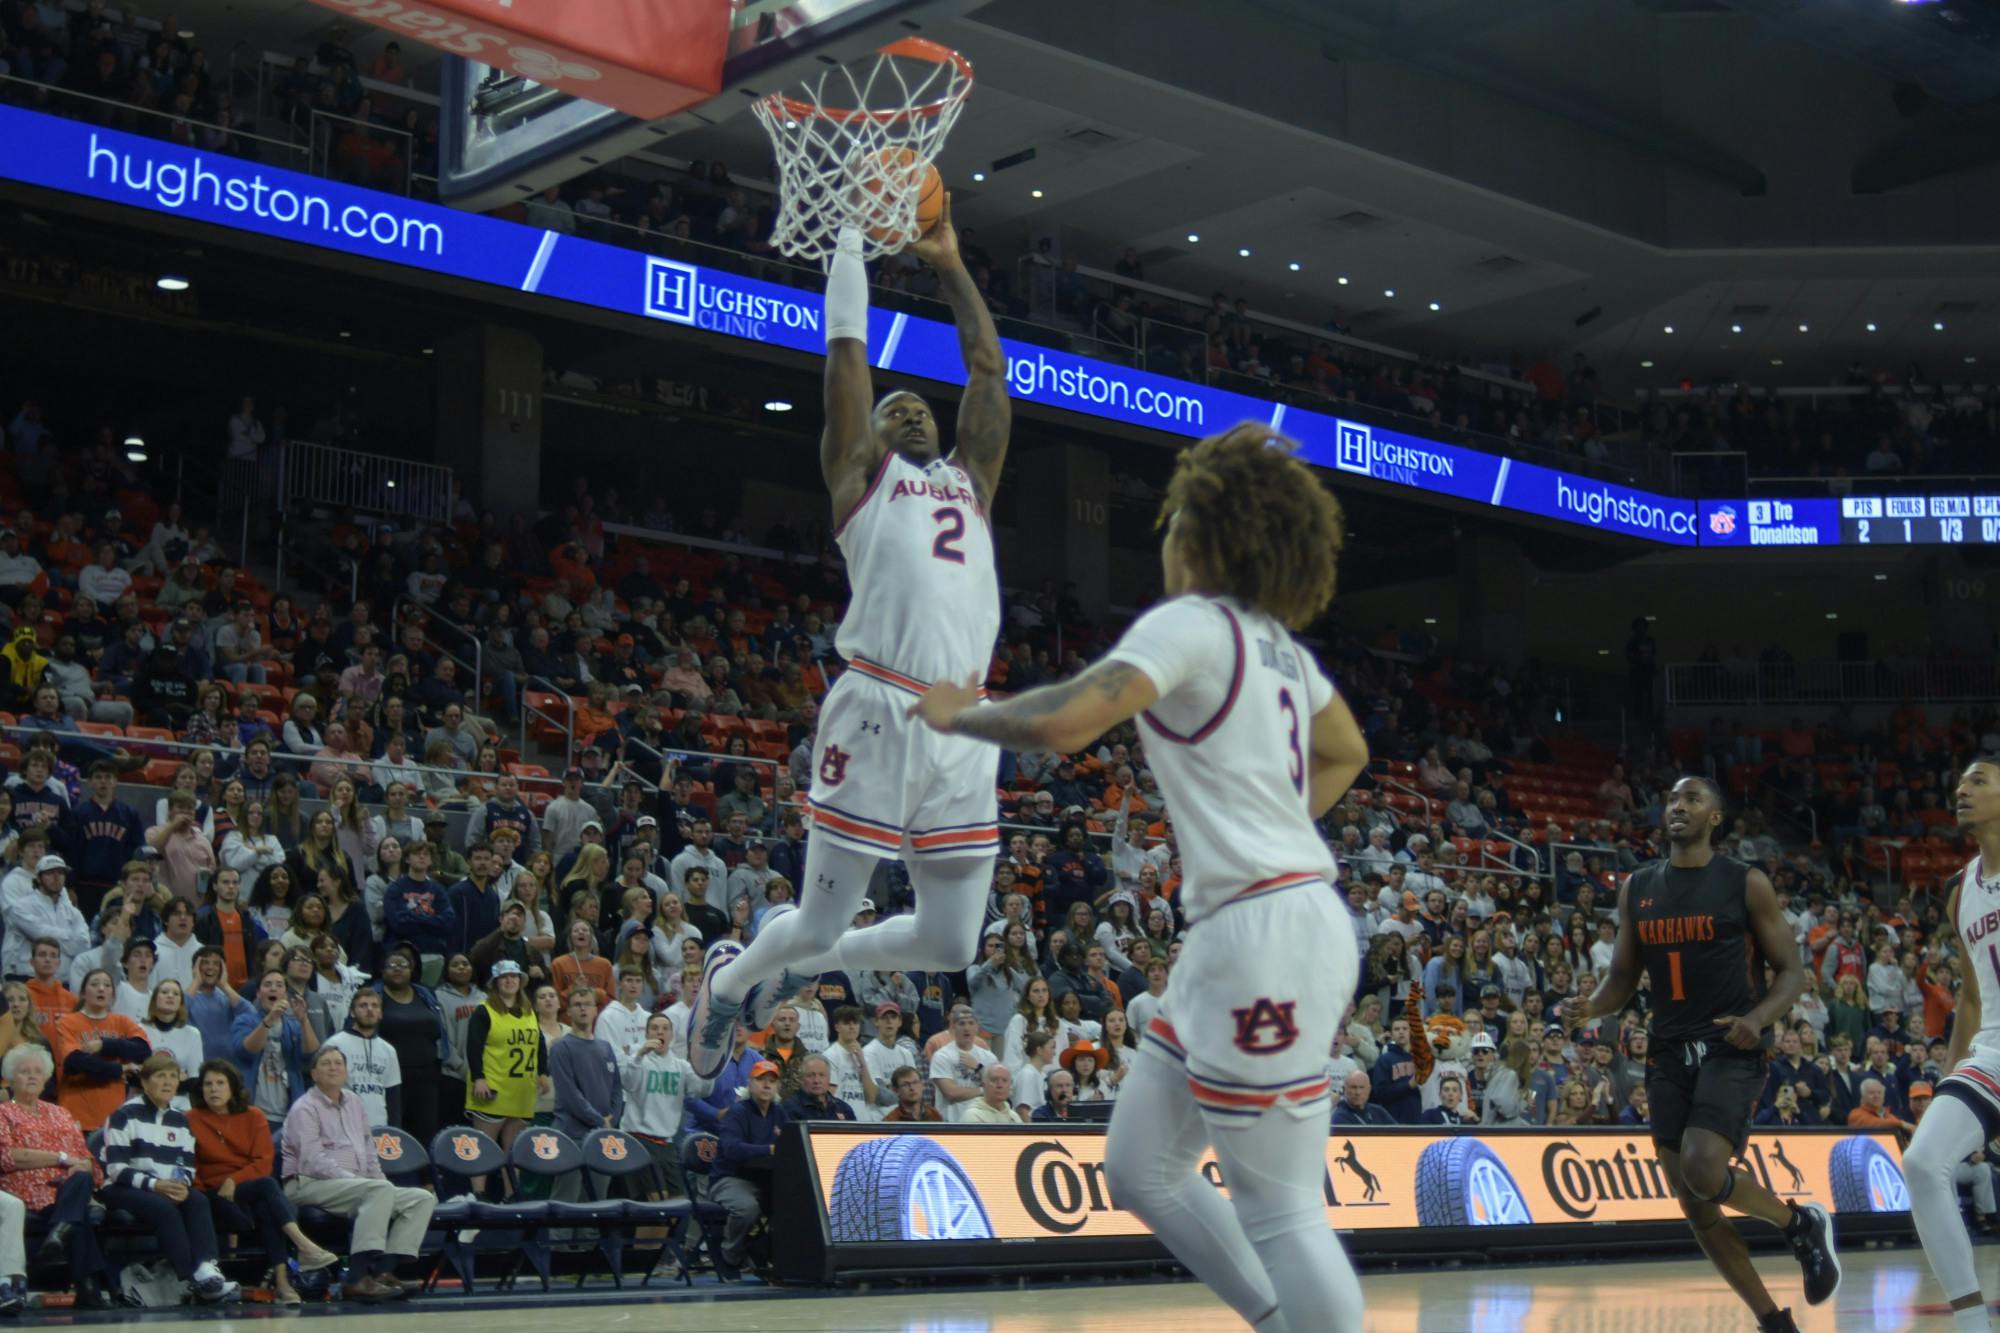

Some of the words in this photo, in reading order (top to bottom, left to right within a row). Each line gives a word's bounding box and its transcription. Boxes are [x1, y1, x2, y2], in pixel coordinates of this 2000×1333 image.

[88, 133, 443, 254] hughston.com
[698, 309, 767, 340] CLINIC
[1773, 501, 1793, 520] Tre
[1853, 500, 1873, 515] PTS
[1891, 500, 1921, 514] FOULS
[931, 506, 965, 566] 2
[1750, 524, 1819, 545] Donaldson
[1858, 519, 1871, 543] 2
[1903, 519, 1912, 543] 1
[1939, 518, 1963, 543] 1/3
[1982, 518, 2000, 543] 0/
[1279, 685, 1304, 798] 3
[1637, 914, 1715, 945] WARHAWKS
[1666, 951, 1686, 1001] 1
[508, 1048, 534, 1078] 24
